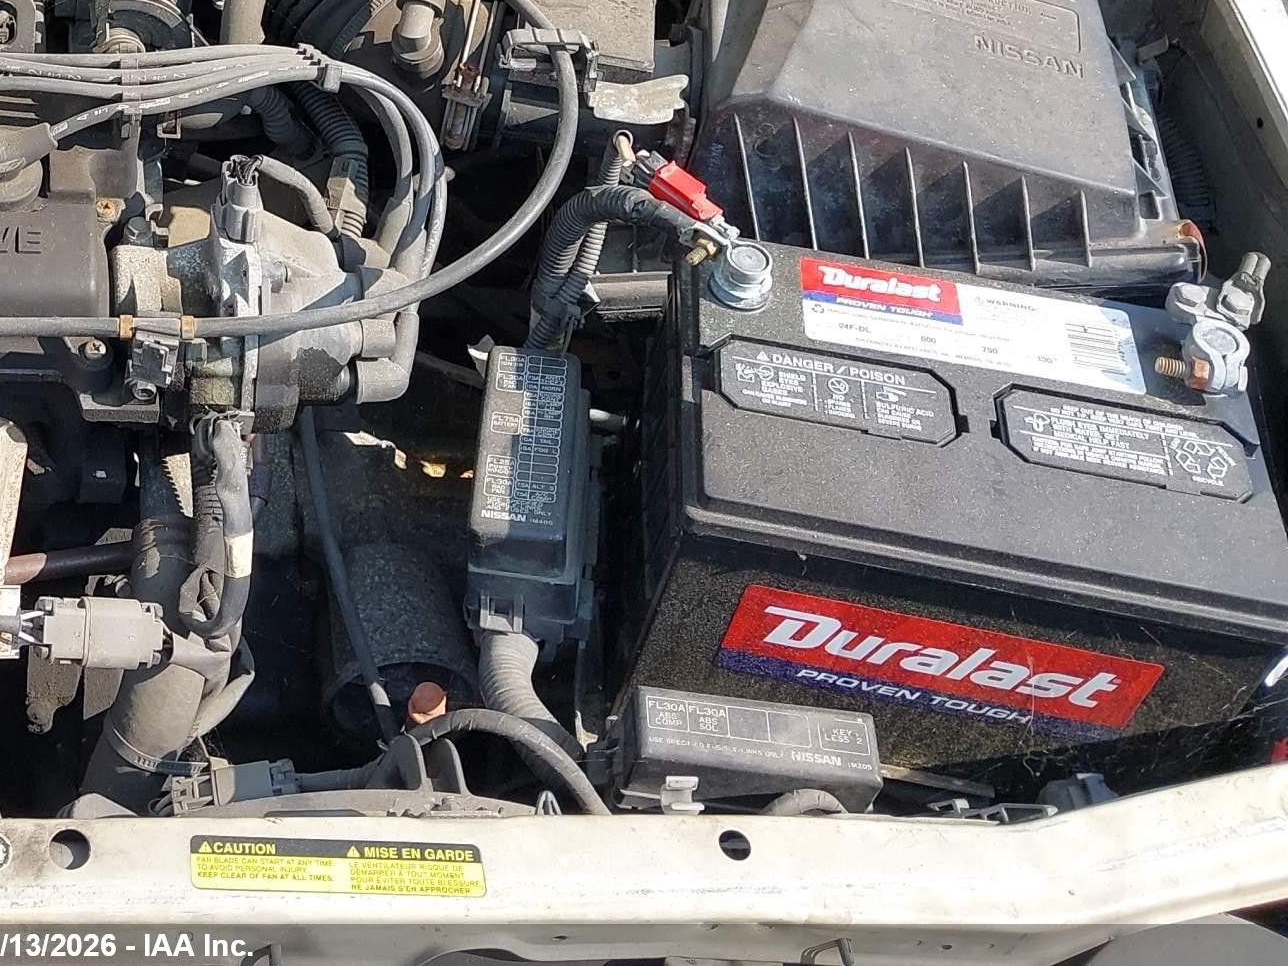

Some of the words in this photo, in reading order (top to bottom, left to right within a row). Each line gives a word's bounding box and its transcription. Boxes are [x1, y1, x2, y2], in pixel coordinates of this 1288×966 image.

[974, 34, 1085, 79] NISSAN
[818, 266, 942, 302] Duralast
[836, 297, 887, 312] PROVEN
[890, 306, 934, 319] TOUGH
[778, 371, 807, 382] SHIELD
[915, 409, 935, 418] ACID
[1110, 439, 1130, 450] FAST
[480, 509, 527, 522] NISSAN
[763, 605, 1118, 708] Duralast
[795, 668, 925, 701] PROVEN
[930, 695, 1033, 725] TOUGH
[648, 700, 686, 713] FL30A
[688, 705, 728, 718] FL30A
[655, 718, 683, 726] COMP
[698, 723, 719, 732] SOL
[657, 711, 678, 721] ABS
[698, 717, 718, 726] ABS
[832, 728, 852, 736] KEY
[824, 733, 851, 744] LESS
[855, 737, 863, 745] 2
[791, 750, 843, 767] NISSAN
[213, 842, 276, 854] CAUTION
[364, 846, 399, 859] MISE
[402, 848, 421, 860] EN
[424, 849, 475, 862] GARDE
[197, 863, 208, 871] TO
[209, 864, 233, 872] AVOID
[220, 872, 247, 880] CLEAR
[262, 873, 278, 881] FAN
[351, 876, 373, 884] POUR
[398, 885, 417, 893] S'EN
